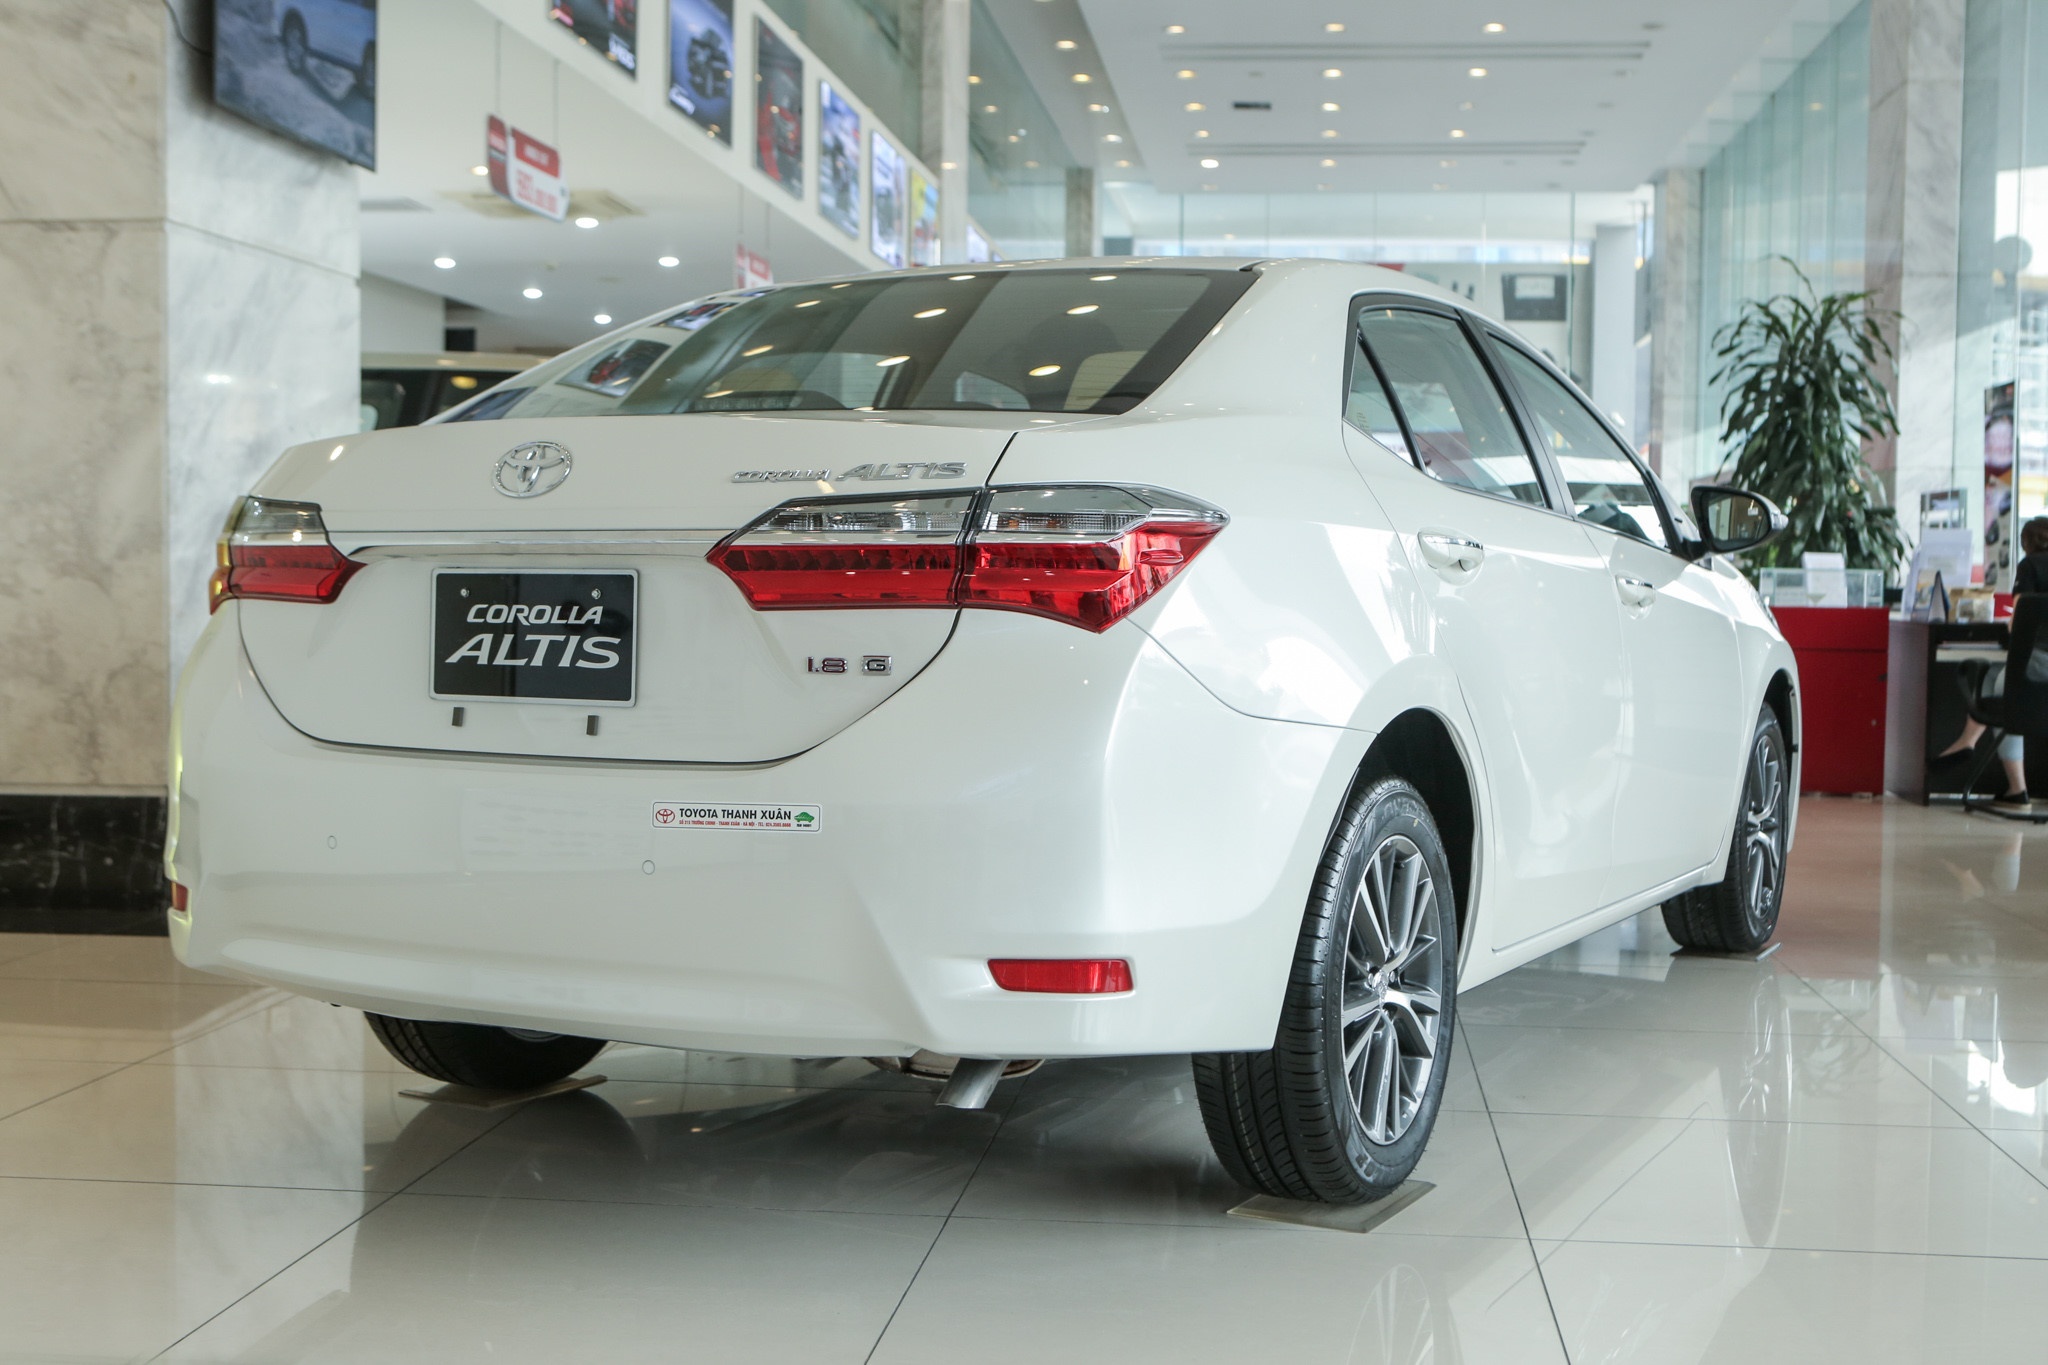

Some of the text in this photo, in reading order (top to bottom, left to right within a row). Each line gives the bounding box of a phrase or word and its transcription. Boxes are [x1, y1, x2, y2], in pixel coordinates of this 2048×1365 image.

[731, 461, 968, 484] COROLLA ALTIS
[466, 603, 604, 626] COROLLA
[444, 633, 622, 669] ALTIS
[807, 655, 892, 676] 1.8 G
[679, 808, 792, 821] TOYOTA THANH XUÂN
